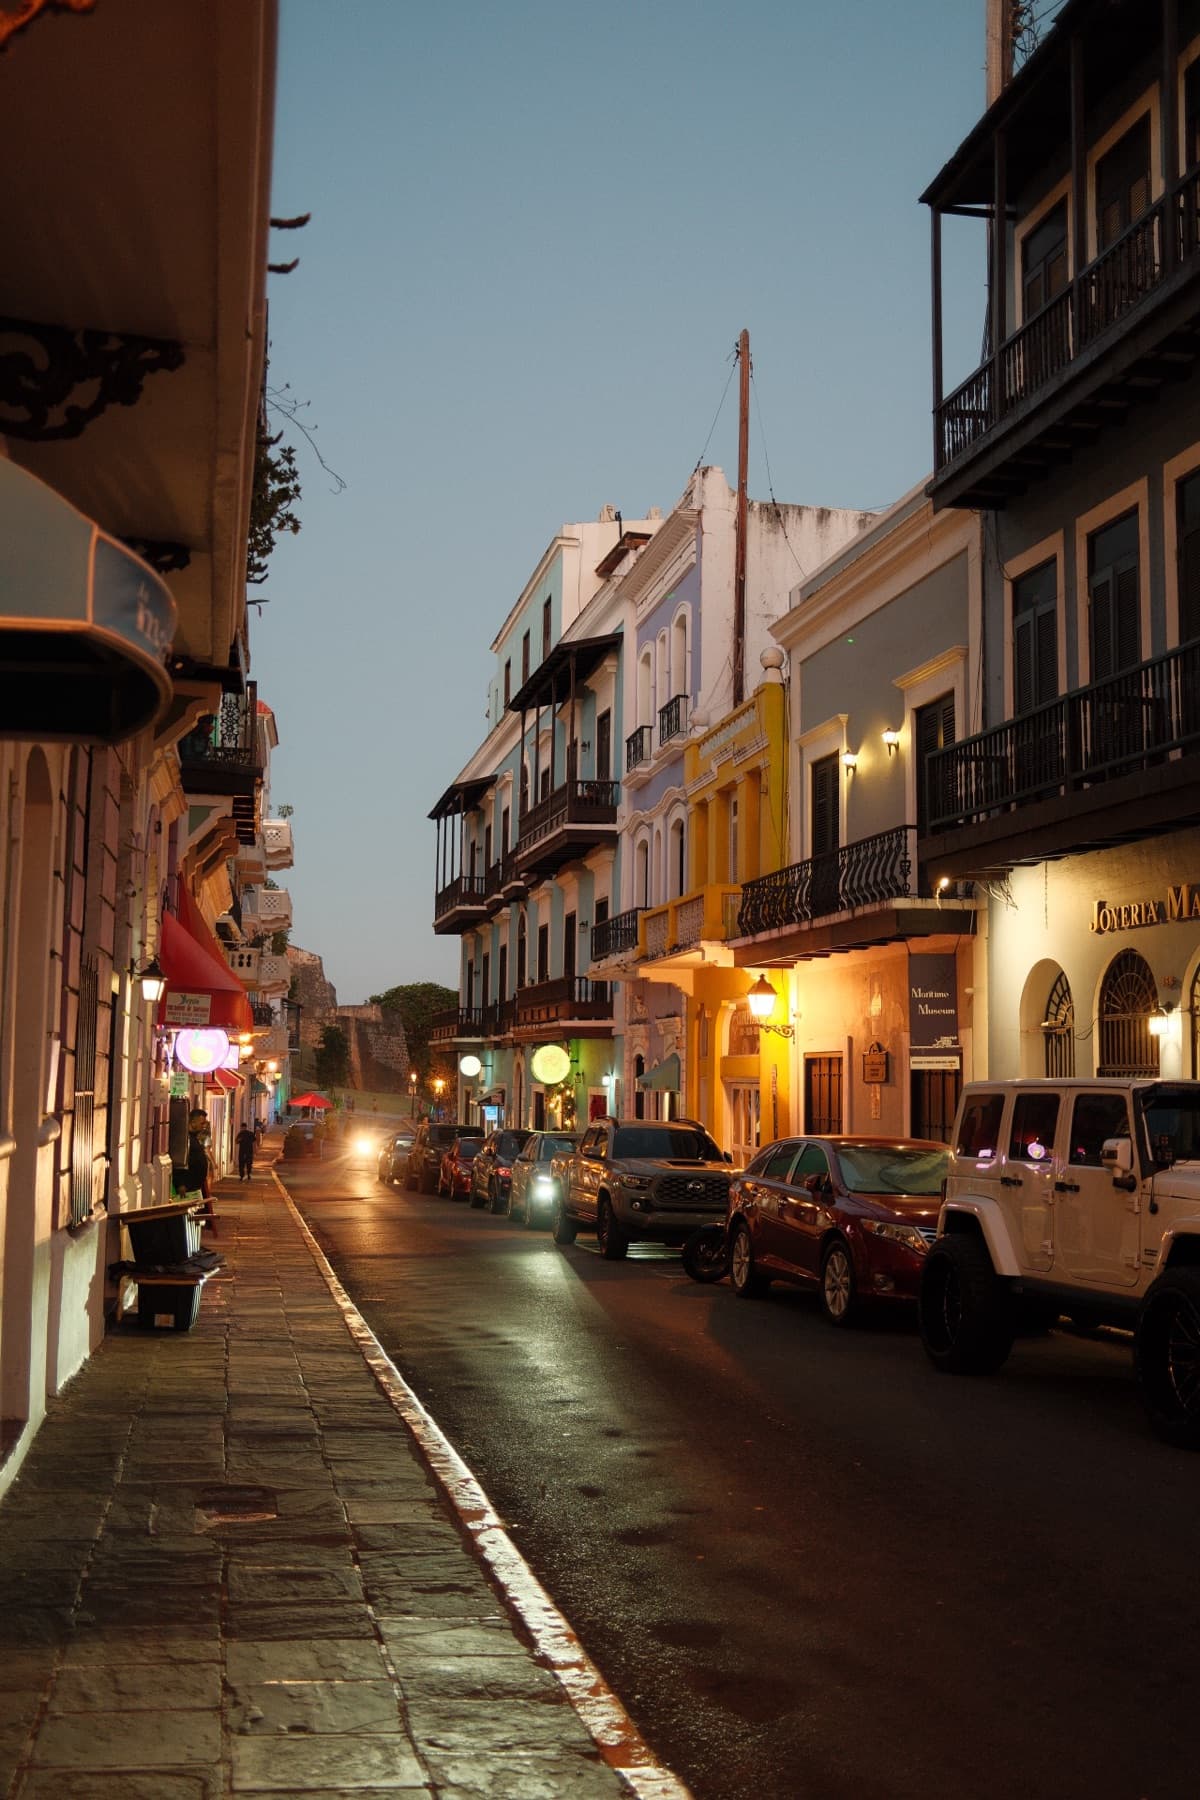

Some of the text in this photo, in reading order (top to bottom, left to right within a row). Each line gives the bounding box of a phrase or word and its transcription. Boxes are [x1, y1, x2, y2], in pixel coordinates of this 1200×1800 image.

[1089, 899, 1159, 932] JOYERIA
[911, 987, 950, 999] Maritime
[918, 1003, 956, 1016] Museum
